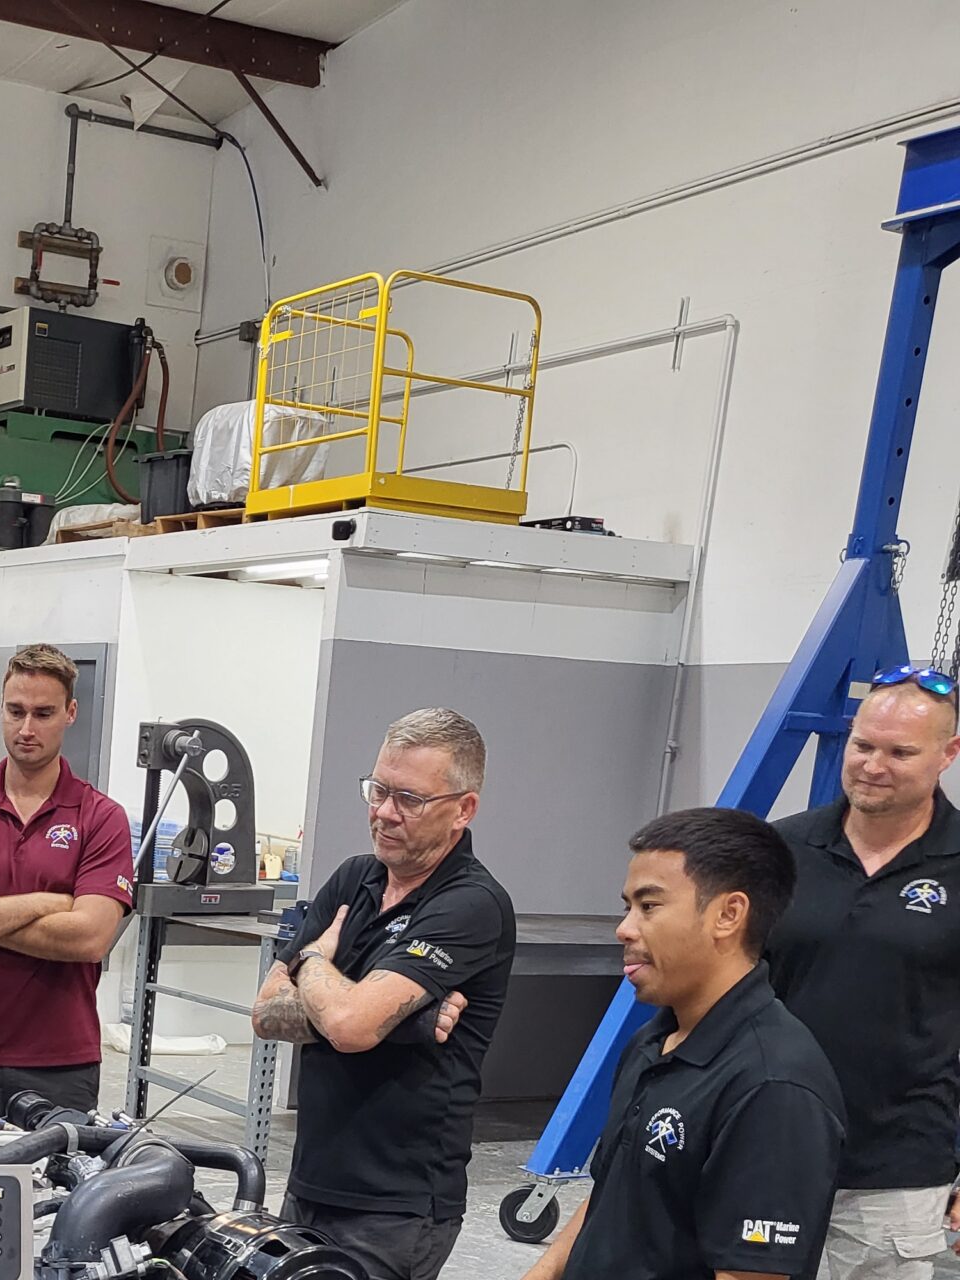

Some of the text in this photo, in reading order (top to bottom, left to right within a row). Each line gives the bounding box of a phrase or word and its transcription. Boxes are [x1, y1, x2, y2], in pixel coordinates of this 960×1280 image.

[406, 939, 435, 957] CAT
[428, 953, 449, 970] Power
[676, 1121, 685, 1151] POWER
[741, 1219, 800, 1243] CAT Marine
[774, 1233, 797, 1245] Power
